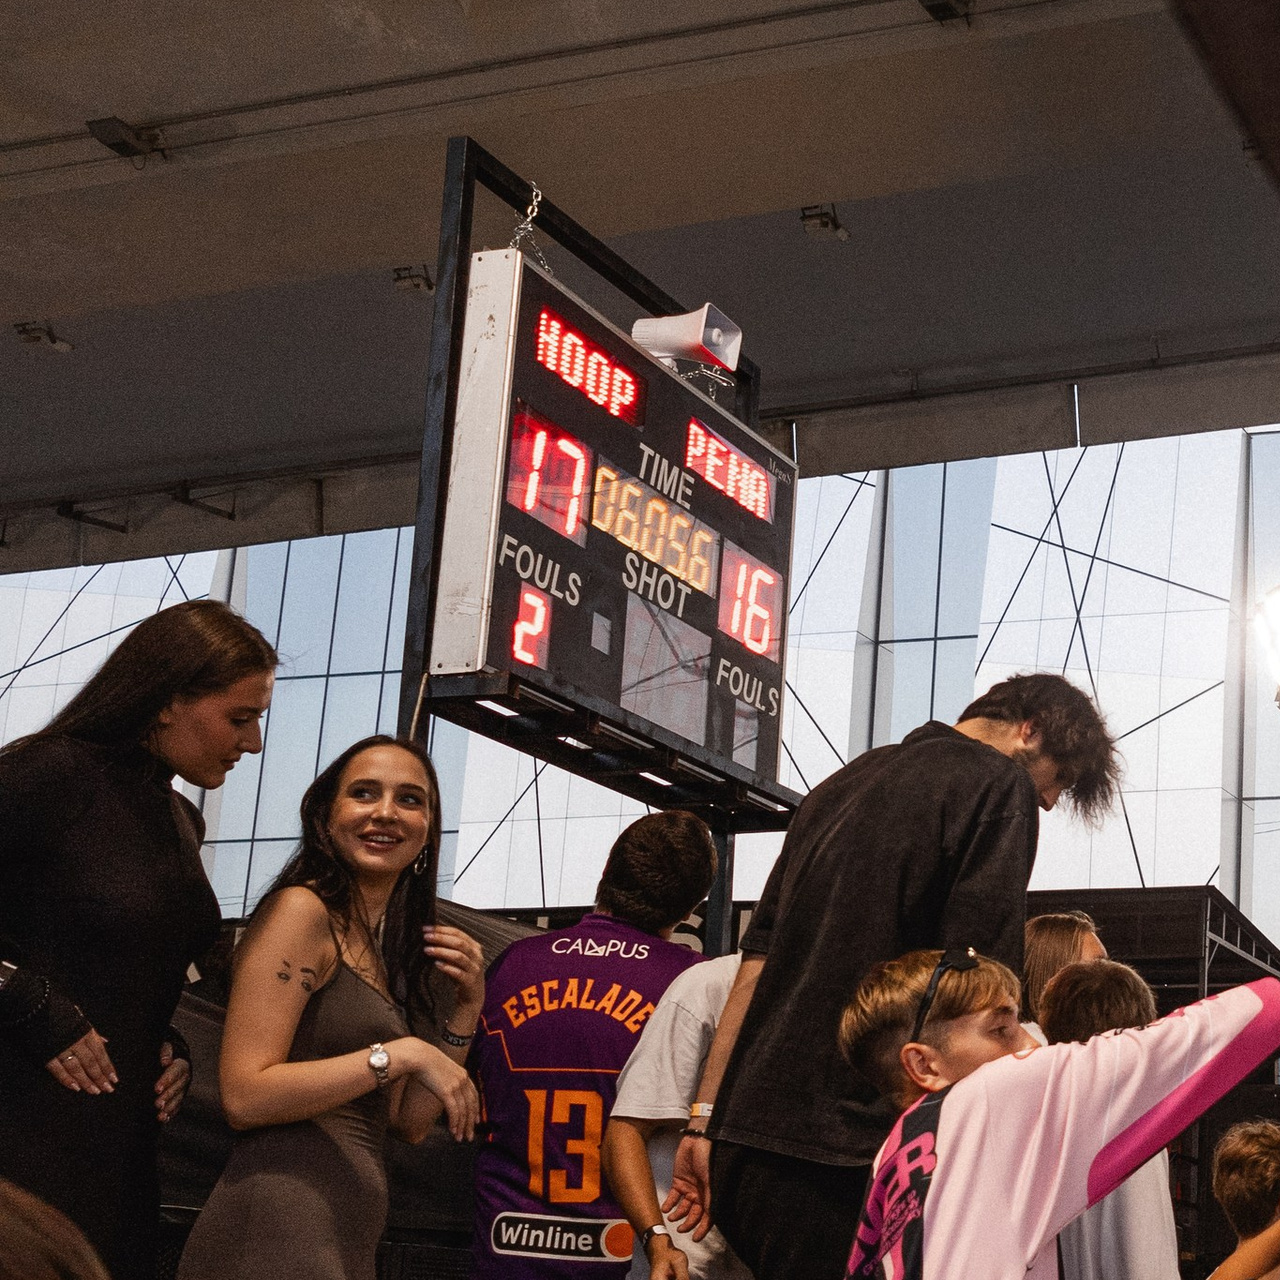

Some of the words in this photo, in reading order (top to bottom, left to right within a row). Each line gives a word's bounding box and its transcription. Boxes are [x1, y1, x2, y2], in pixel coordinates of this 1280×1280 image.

[537, 312, 635, 417] HOOP
[524, 430, 586, 535] 17
[638, 442, 696, 510] TIME
[499, 534, 582, 607] FOULS
[622, 551, 692, 618] SHOT
[512, 592, 547, 665] 2
[731, 563, 774, 655] 16
[716, 658, 779, 717] FOULS
[524, 1089, 603, 1204] 13
[501, 1222, 593, 1251] Winline
